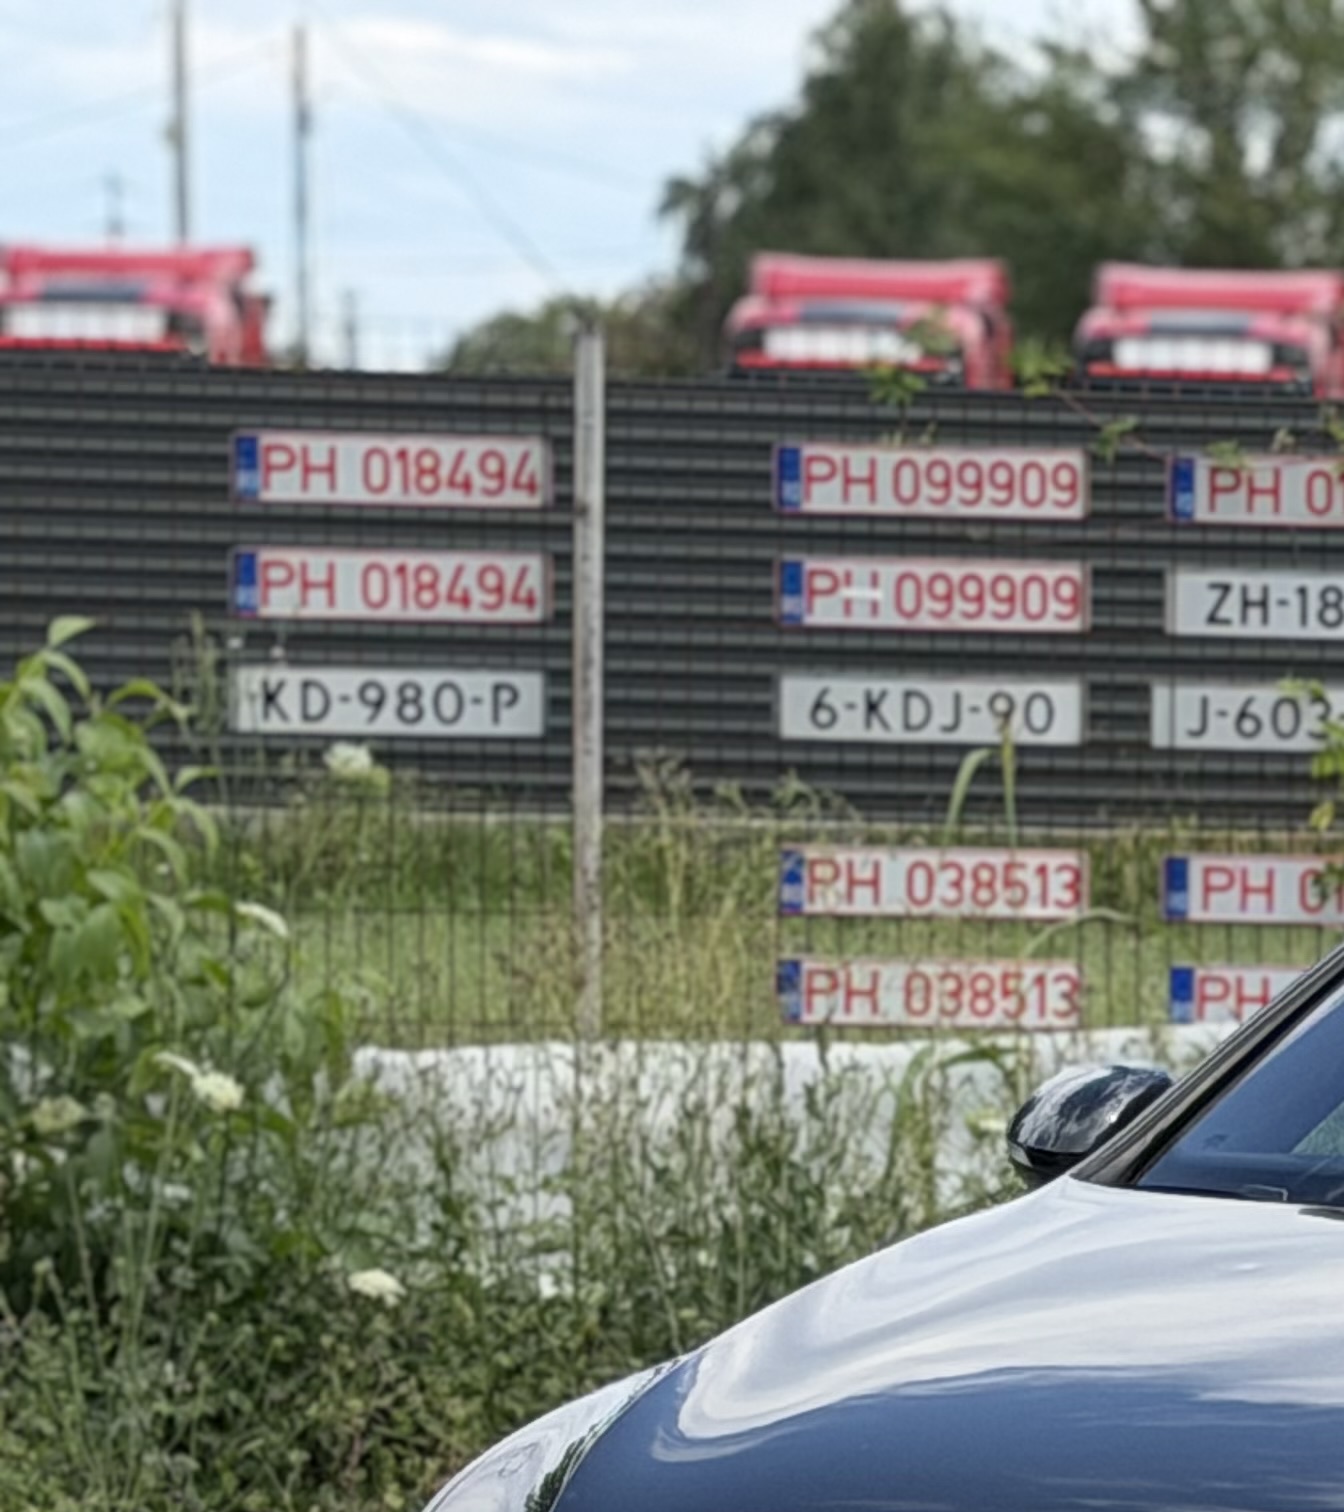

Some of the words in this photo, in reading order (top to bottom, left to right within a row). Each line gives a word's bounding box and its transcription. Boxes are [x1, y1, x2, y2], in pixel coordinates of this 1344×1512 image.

[262, 444, 337, 493] PH
[363, 447, 540, 497] 018494
[804, 455, 878, 504] PH
[892, 457, 1079, 508] 099909
[1208, 466, 1281, 514] PH
[261, 560, 336, 609] PH
[361, 562, 538, 612] 018494
[807, 569, 880, 619] PH
[894, 571, 1082, 622] 099909
[261, 677, 520, 727] KD-980-P
[809, 685, 1056, 735] 6-KDJ-90
[807, 858, 881, 906] PH
[907, 860, 1082, 909] 038513
[1202, 866, 1275, 915] PH
[805, 967, 880, 1016] PH
[903, 970, 1081, 1020] 038513
[1197, 975, 1271, 1020] PH
